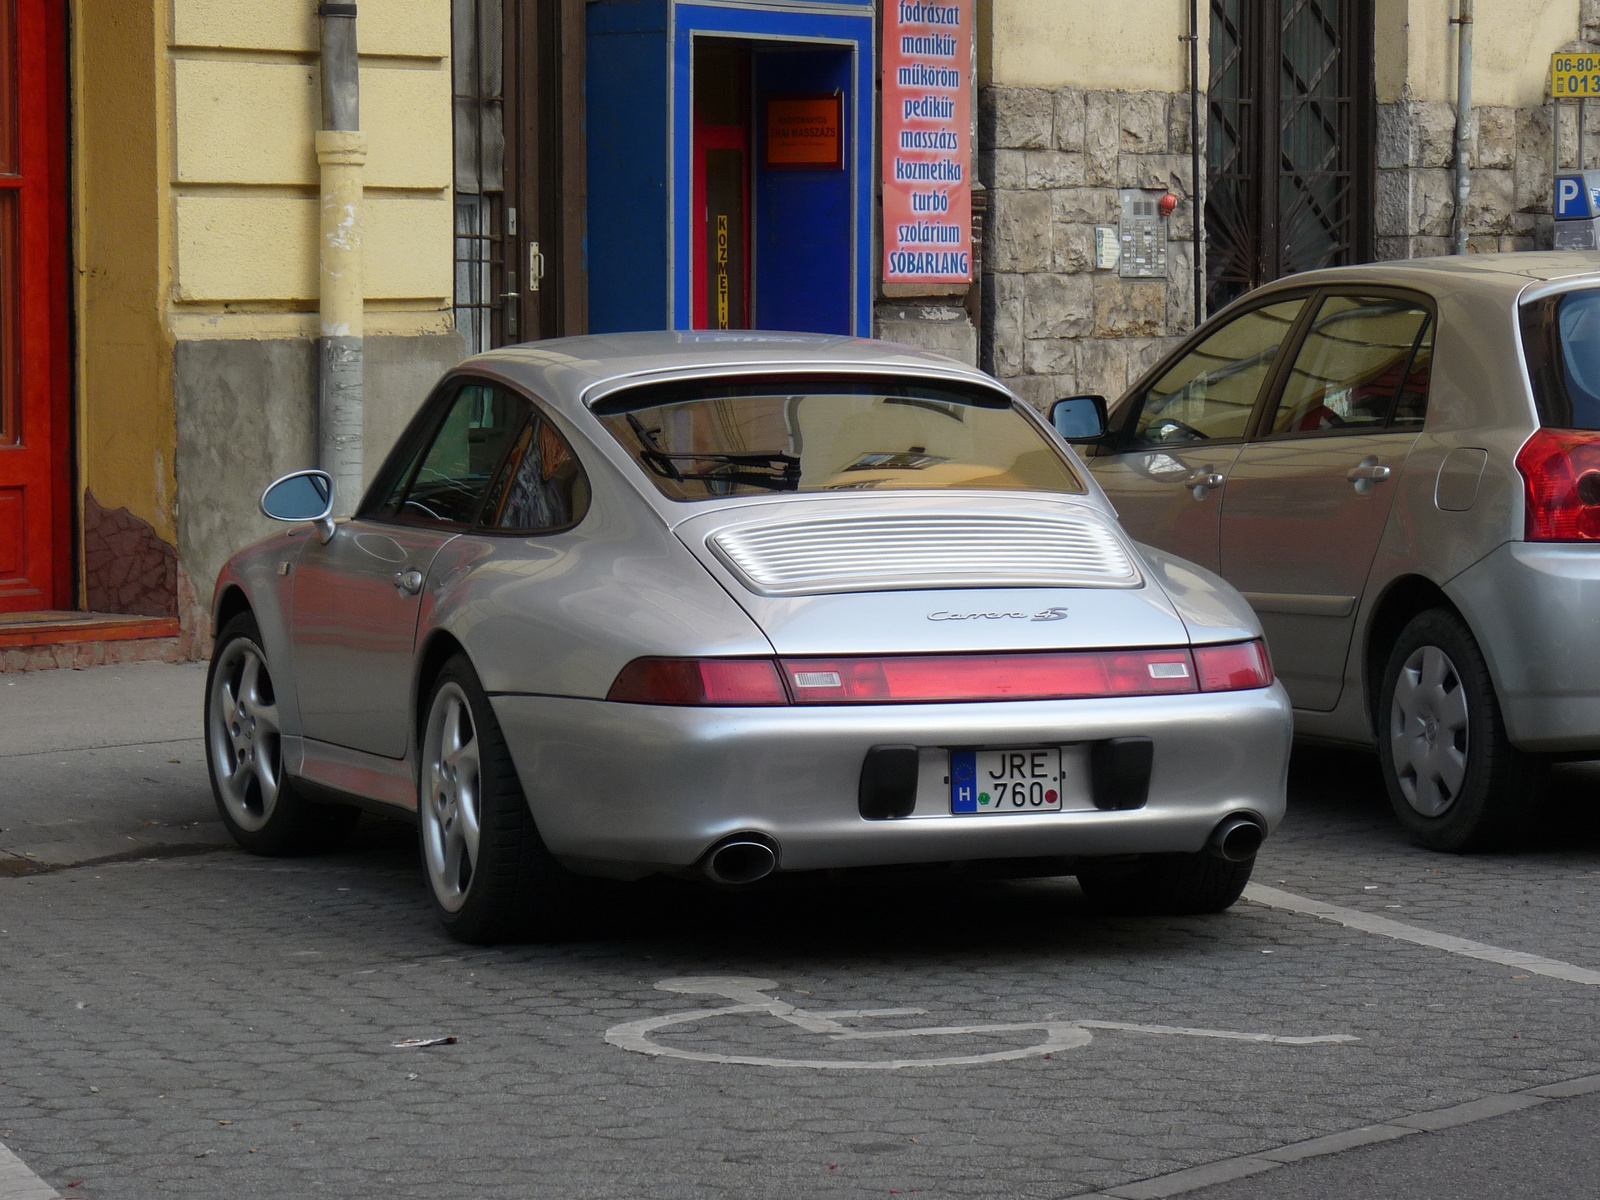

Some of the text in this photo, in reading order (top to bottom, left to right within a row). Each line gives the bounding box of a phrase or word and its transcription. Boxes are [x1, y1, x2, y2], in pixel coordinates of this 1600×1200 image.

[899, 0, 960, 25] fodrászat
[902, 33, 957, 56] manikűr
[898, 64, 959, 88] műköröm
[904, 96, 955, 119] pedikűr
[792, 126, 837, 138] MASSZÁZS
[901, 128, 958, 150] masszázs
[896, 157, 961, 181] kozmetika
[911, 190, 948, 212] turbó
[1559, 179, 1579, 214] P
[898, 221, 960, 243] szolárium
[889, 247, 968, 274] SÓBARLANG
[926, 606, 1069, 622] Carrera 4S
[988, 752, 1048, 780] JRE
[959, 786, 971, 802] H
[993, 781, 1044, 808] 760
